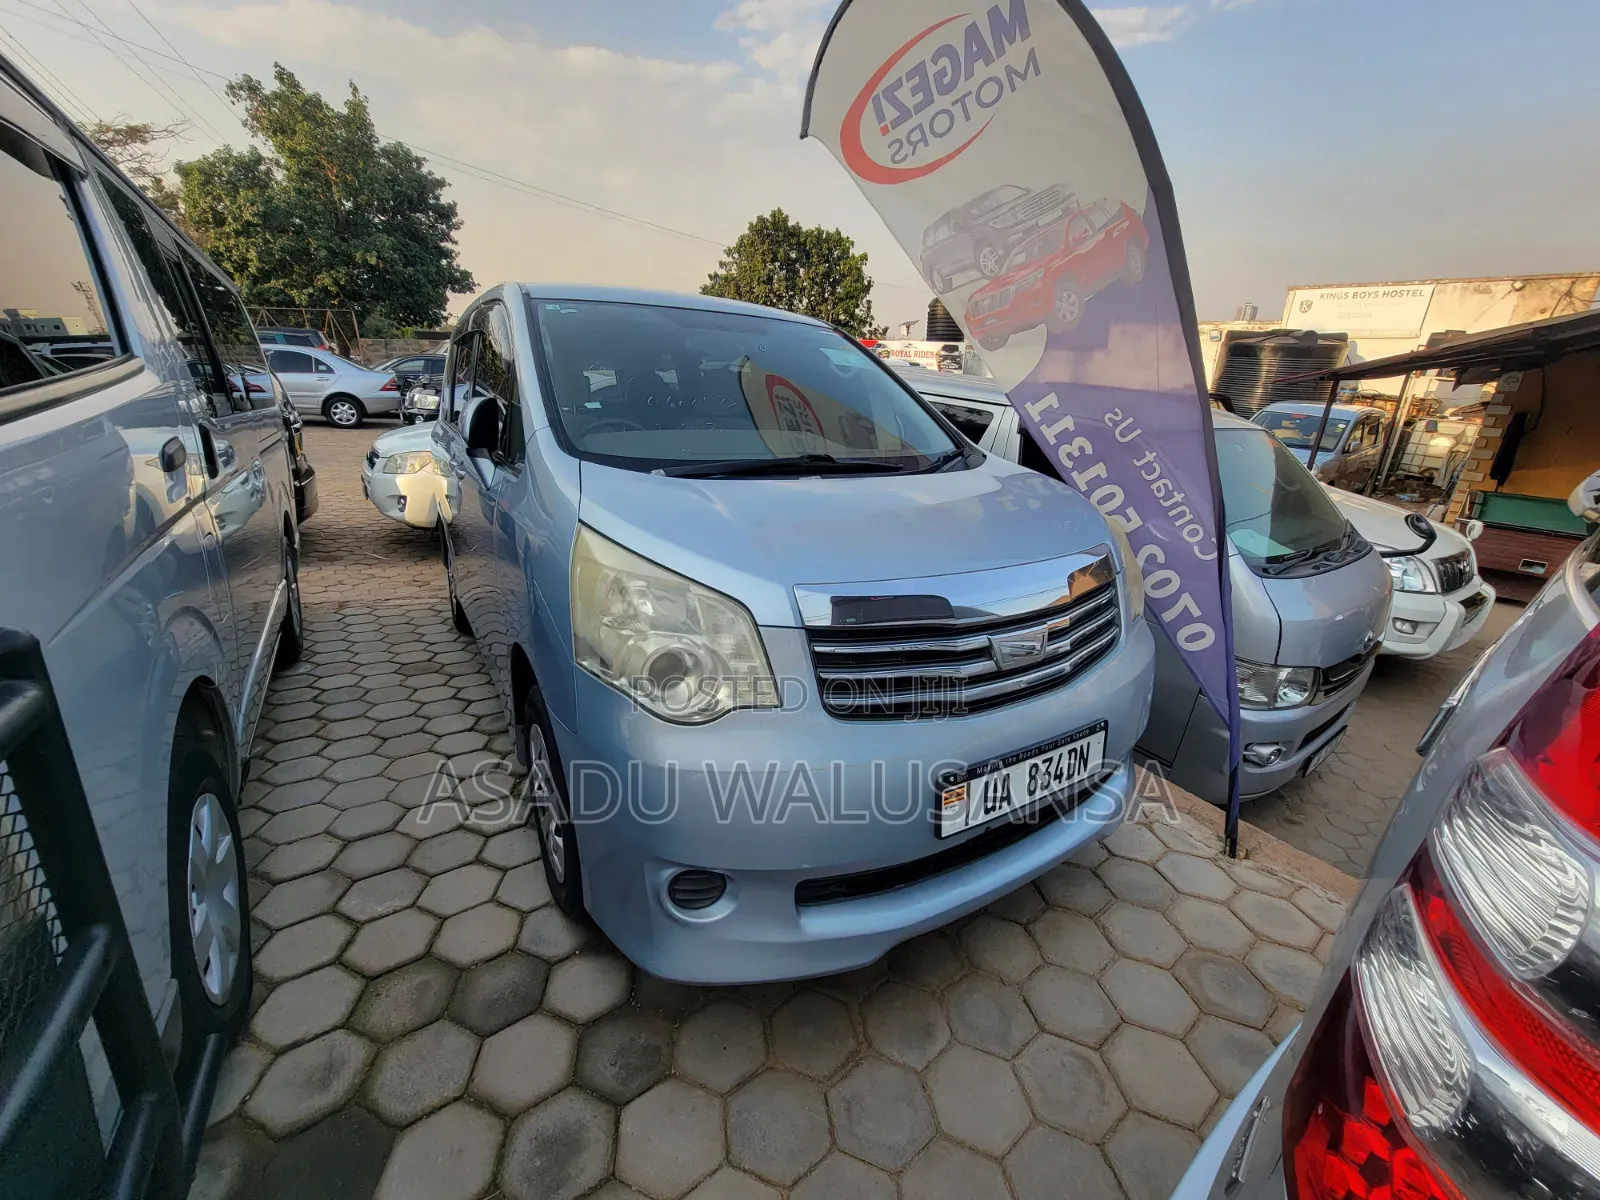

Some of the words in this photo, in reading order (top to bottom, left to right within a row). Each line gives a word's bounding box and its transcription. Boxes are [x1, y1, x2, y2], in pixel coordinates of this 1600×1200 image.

[1319, 291, 1349, 300] KINGS
[1352, 290, 1379, 299] BOYS
[1381, 289, 1425, 299] HOSTEL
[890, 349, 912, 358] ROYAL
[913, 350, 935, 359] RIDES
[1005, 756, 1017, 765] the
[1018, 749, 1039, 761] Roads
[1042, 742, 1056, 752] Your
[1057, 736, 1071, 746] Safe
[1072, 729, 1090, 740] Space
[983, 772, 1012, 815] UA
[1026, 741, 1091, 797] 834DN
